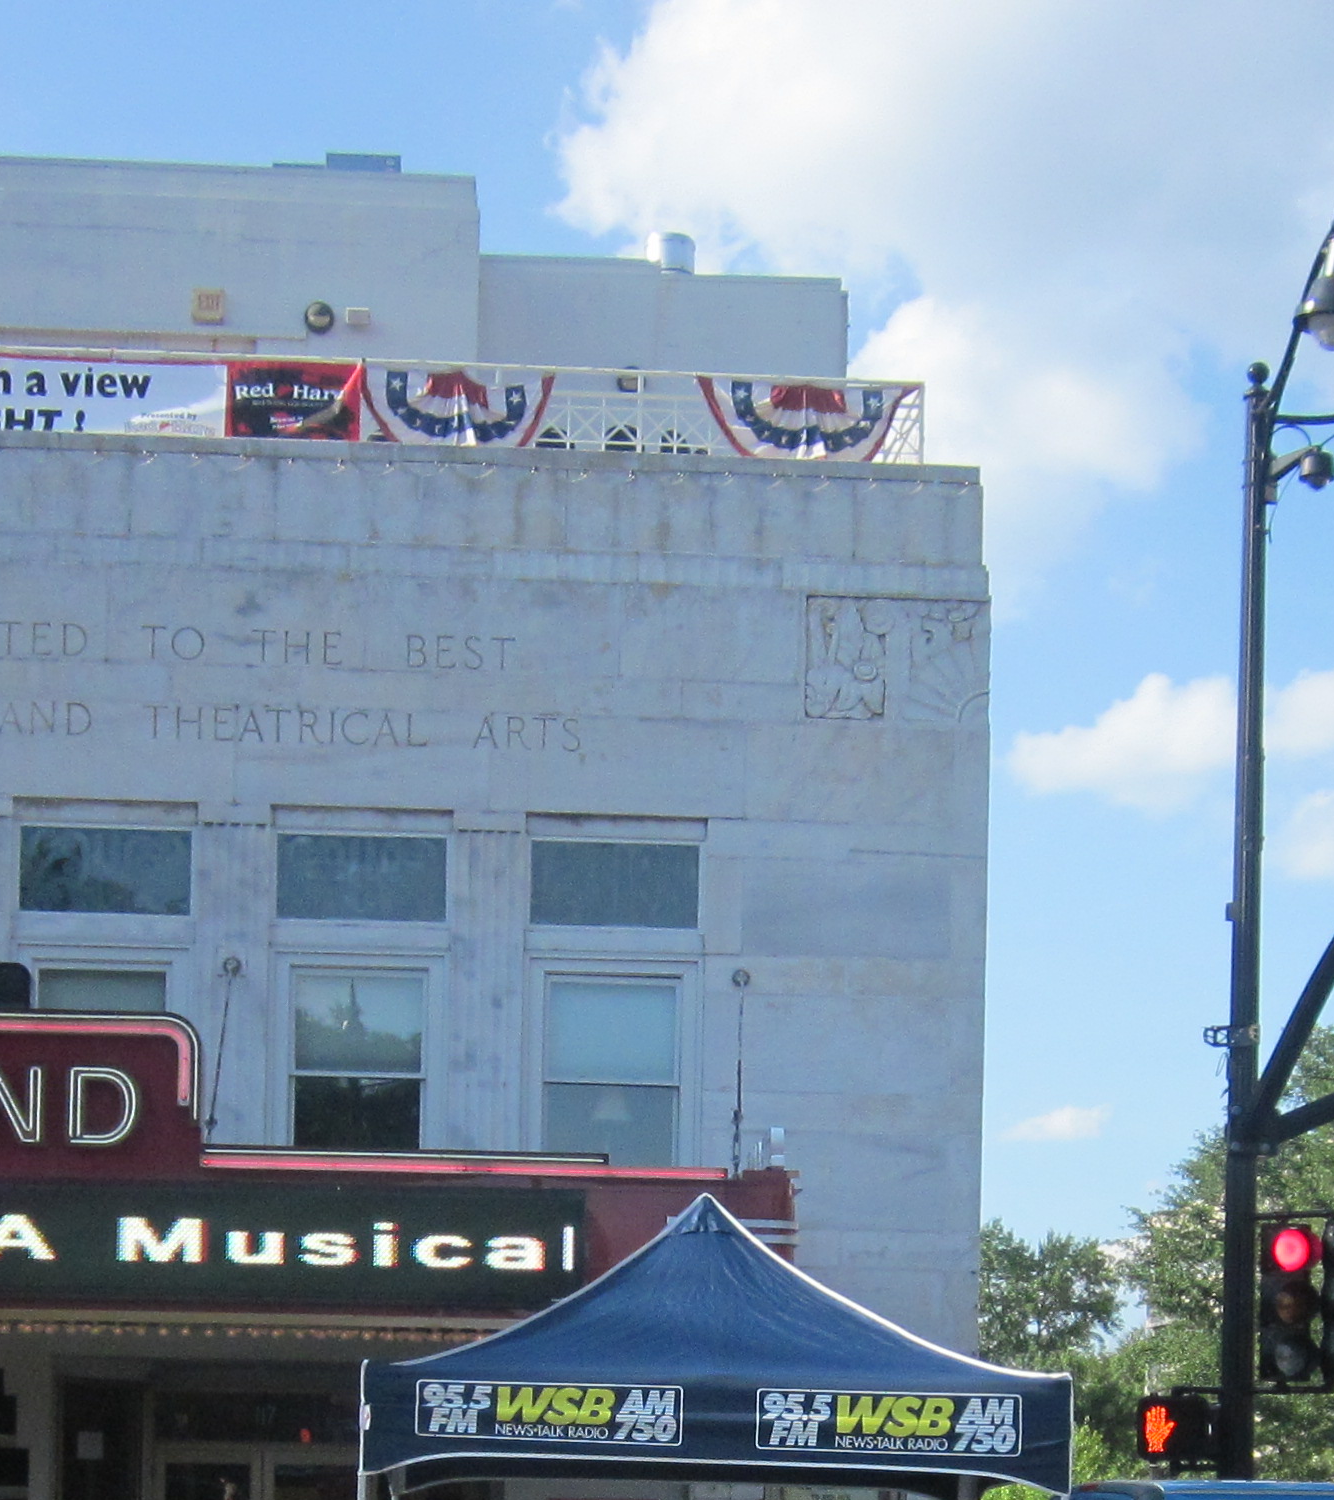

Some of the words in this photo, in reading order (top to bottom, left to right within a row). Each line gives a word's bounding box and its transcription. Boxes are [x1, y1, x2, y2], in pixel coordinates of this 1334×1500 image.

[25, 371, 47, 396] a
[60, 367, 152, 399] view
[235, 382, 275, 400] Red
[140, 624, 205, 661] TO
[252, 628, 343, 666] THE
[406, 634, 516, 671] BEST
[142, 704, 428, 747] THEATRICAL
[473, 711, 582, 752] ARTS
[115, 1215, 575, 1272] Musical
[422, 1383, 493, 1409] 95.5
[495, 1386, 616, 1425] WSB
[617, 1389, 675, 1416] AM
[761, 1392, 833, 1422] 95.5
[836, 1395, 955, 1437] WSB
[957, 1397, 1015, 1425] AM
[428, 1407, 478, 1433] FM
[613, 1414, 677, 1442] 750
[567, 1426, 609, 1440] RADIO
[769, 1420, 820, 1447] FM
[953, 1424, 1017, 1453] 750
[907, 1437, 949, 1451] RADIO
